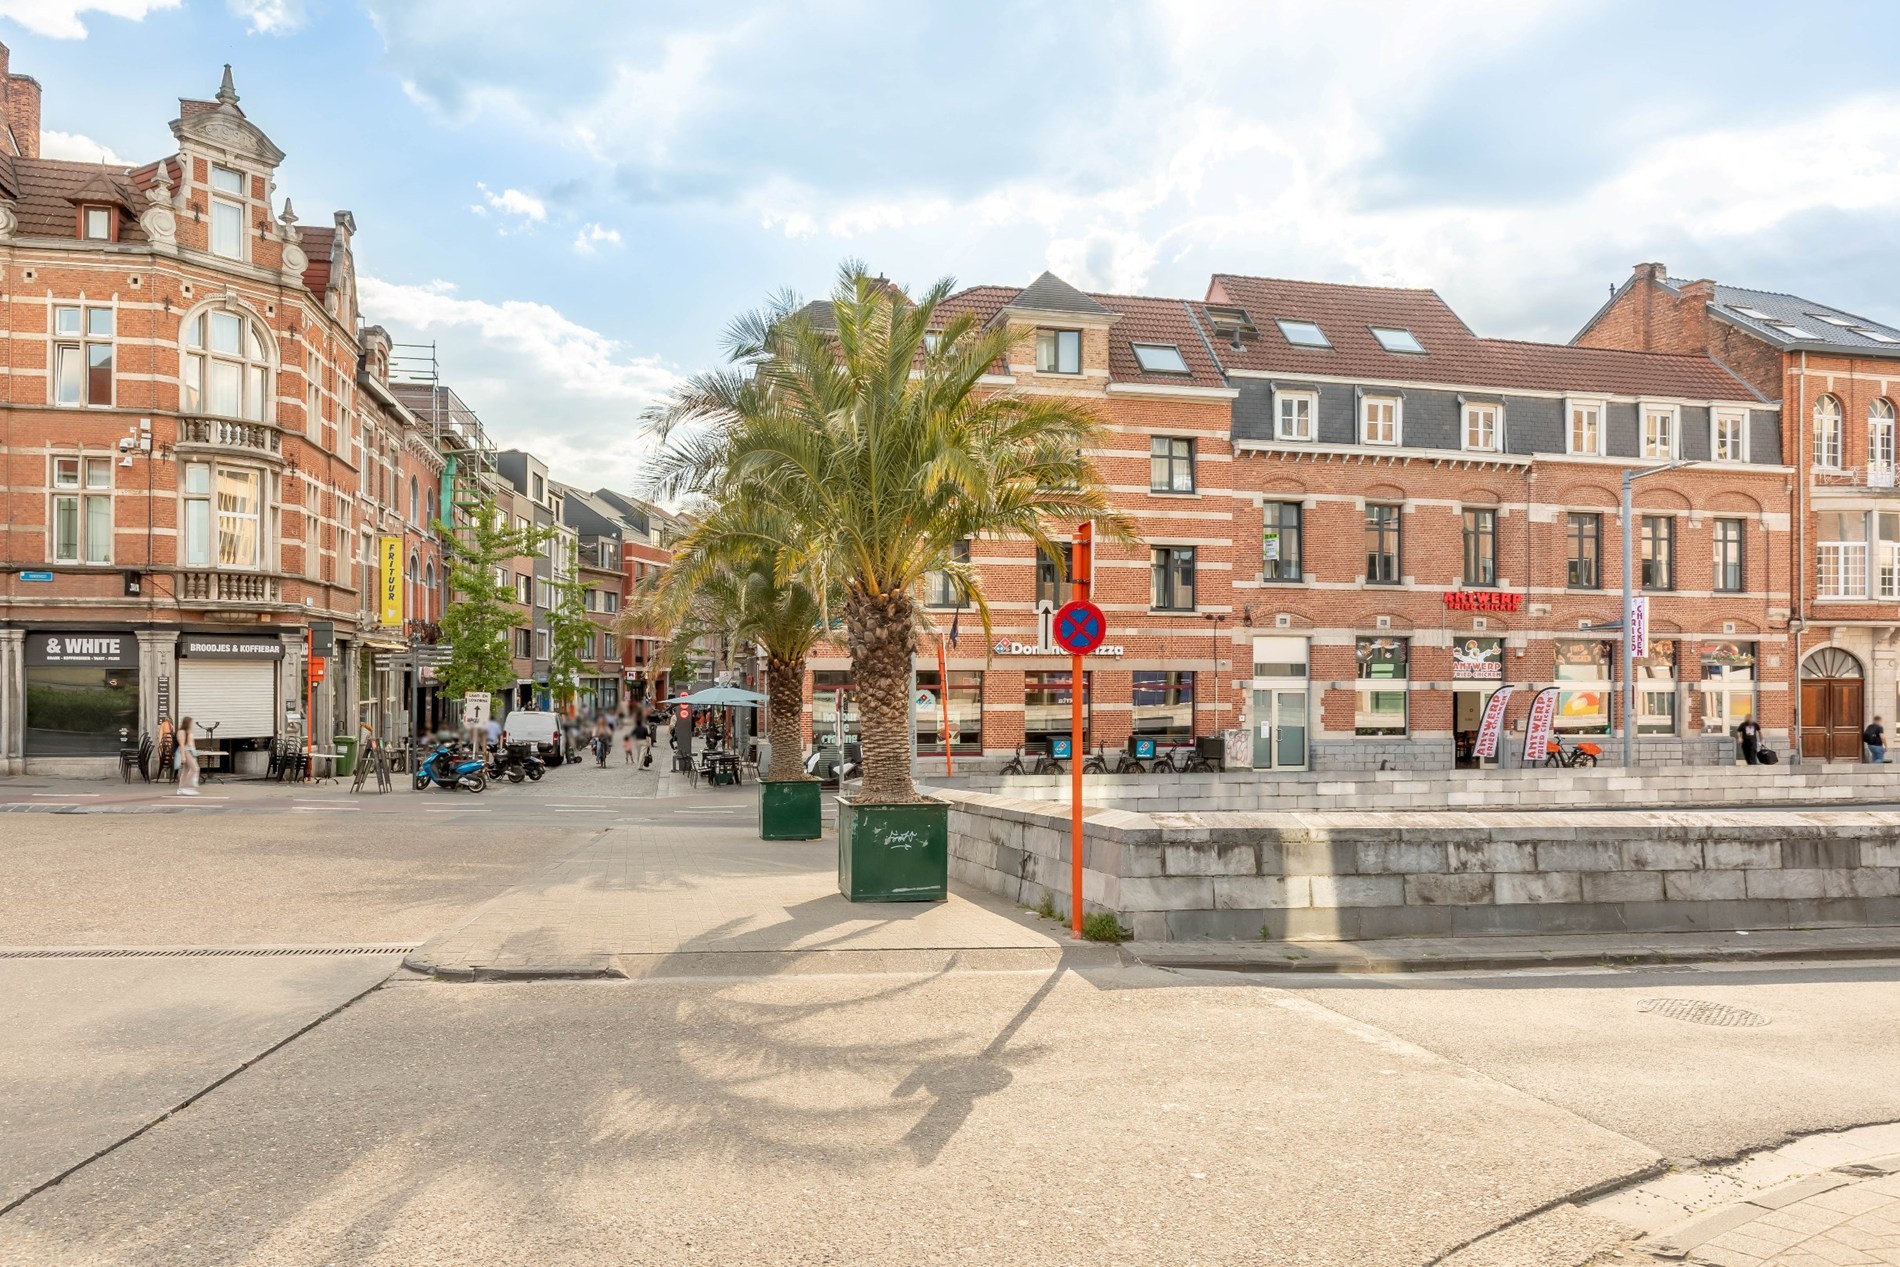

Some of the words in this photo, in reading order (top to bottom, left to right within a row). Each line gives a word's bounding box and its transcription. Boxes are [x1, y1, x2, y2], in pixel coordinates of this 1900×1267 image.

[1444, 592, 1523, 604] ANTWERP
[1448, 603, 1476, 611] FRIED
[1479, 603, 1519, 611] CHICKEN
[46, 638, 61, 653] &
[65, 639, 120, 654] WHITE
[190, 643, 230, 652] BROODJES
[232, 644, 238, 652] &
[240, 645, 280, 653] KOFFIEBAR
[1092, 645, 1123, 655] izza
[1453, 662, 1501, 671] ANTWERP
[1540, 697, 1554, 733] CHICKEN
[1476, 694, 1500, 756] ANTWERP
[1527, 696, 1546, 758] ANTWERP
[1486, 731, 1496, 757] FRIED
[1537, 734, 1545, 759] FRIED
